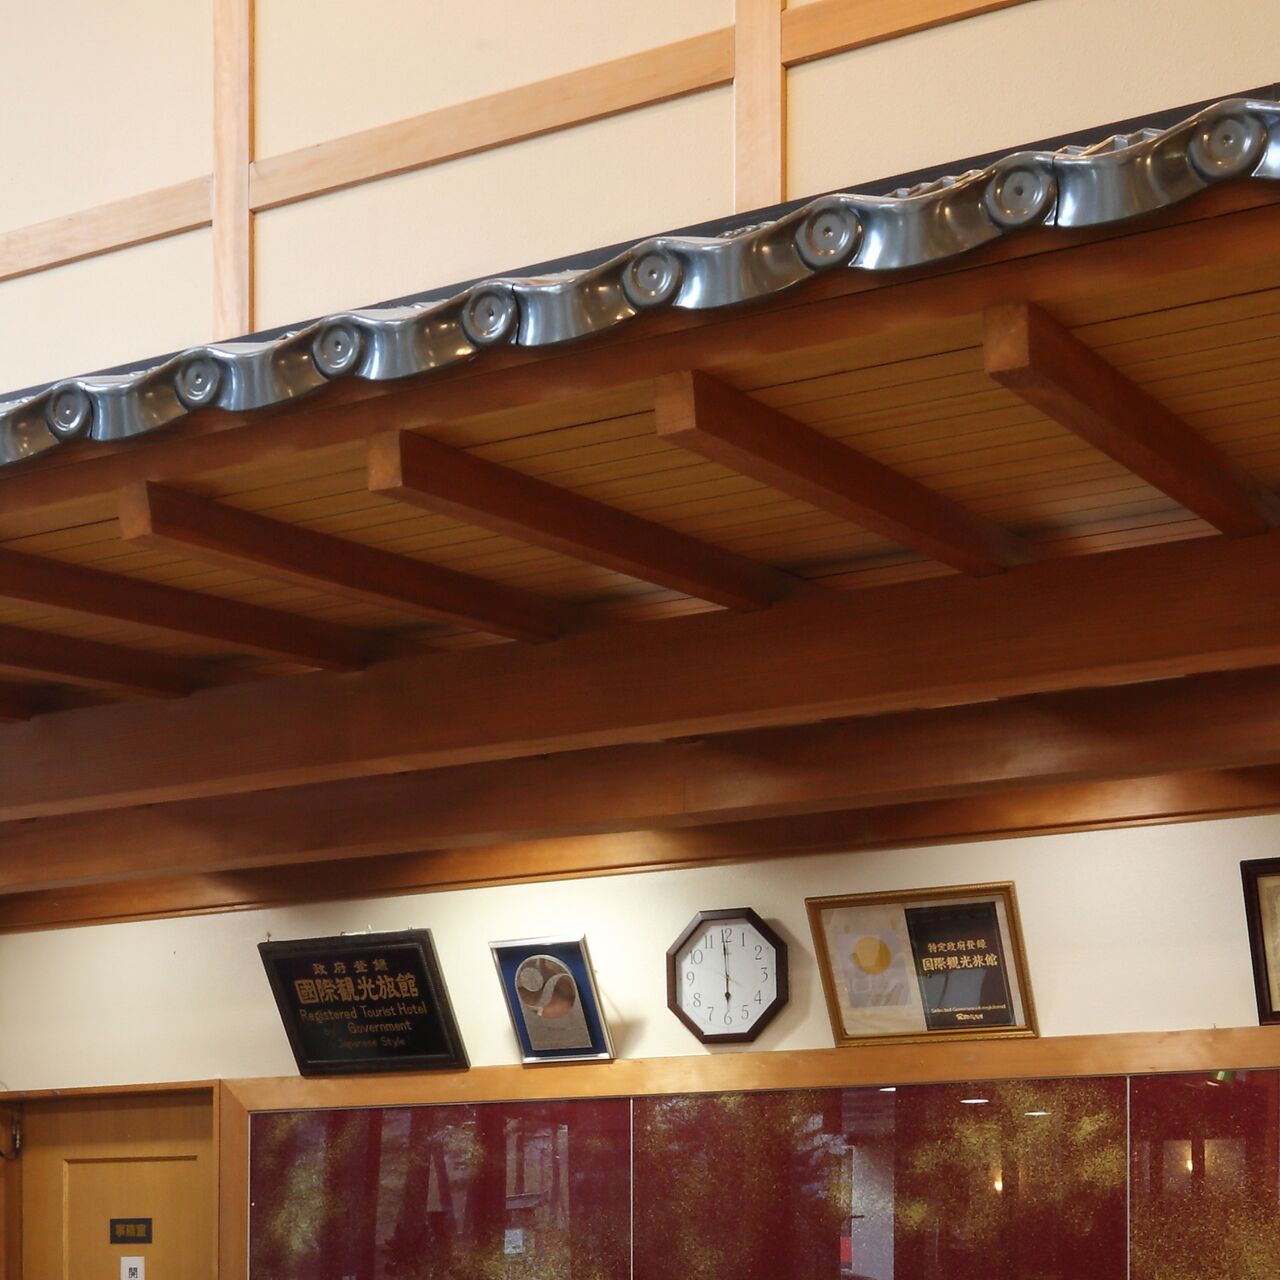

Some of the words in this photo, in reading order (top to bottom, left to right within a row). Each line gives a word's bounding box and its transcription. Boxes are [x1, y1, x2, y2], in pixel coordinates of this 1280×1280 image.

[690, 949, 703, 964] 10
[754, 945, 762, 960] 2
[922, 953, 998, 971] 国際観光旅館
[686, 971, 695, 986] 9
[761, 967, 768, 983] 3
[693, 993, 701, 1008] 8
[754, 990, 761, 1005] 4
[299, 1007, 358, 1023] Registered
[360, 1004, 396, 1018] Tourist
[397, 1001, 427, 1016] Hotel
[707, 1007, 714, 1022] 7
[724, 1009, 732, 1025] 6
[741, 1005, 749, 1020] 5
[347, 1020, 413, 1034] Government
